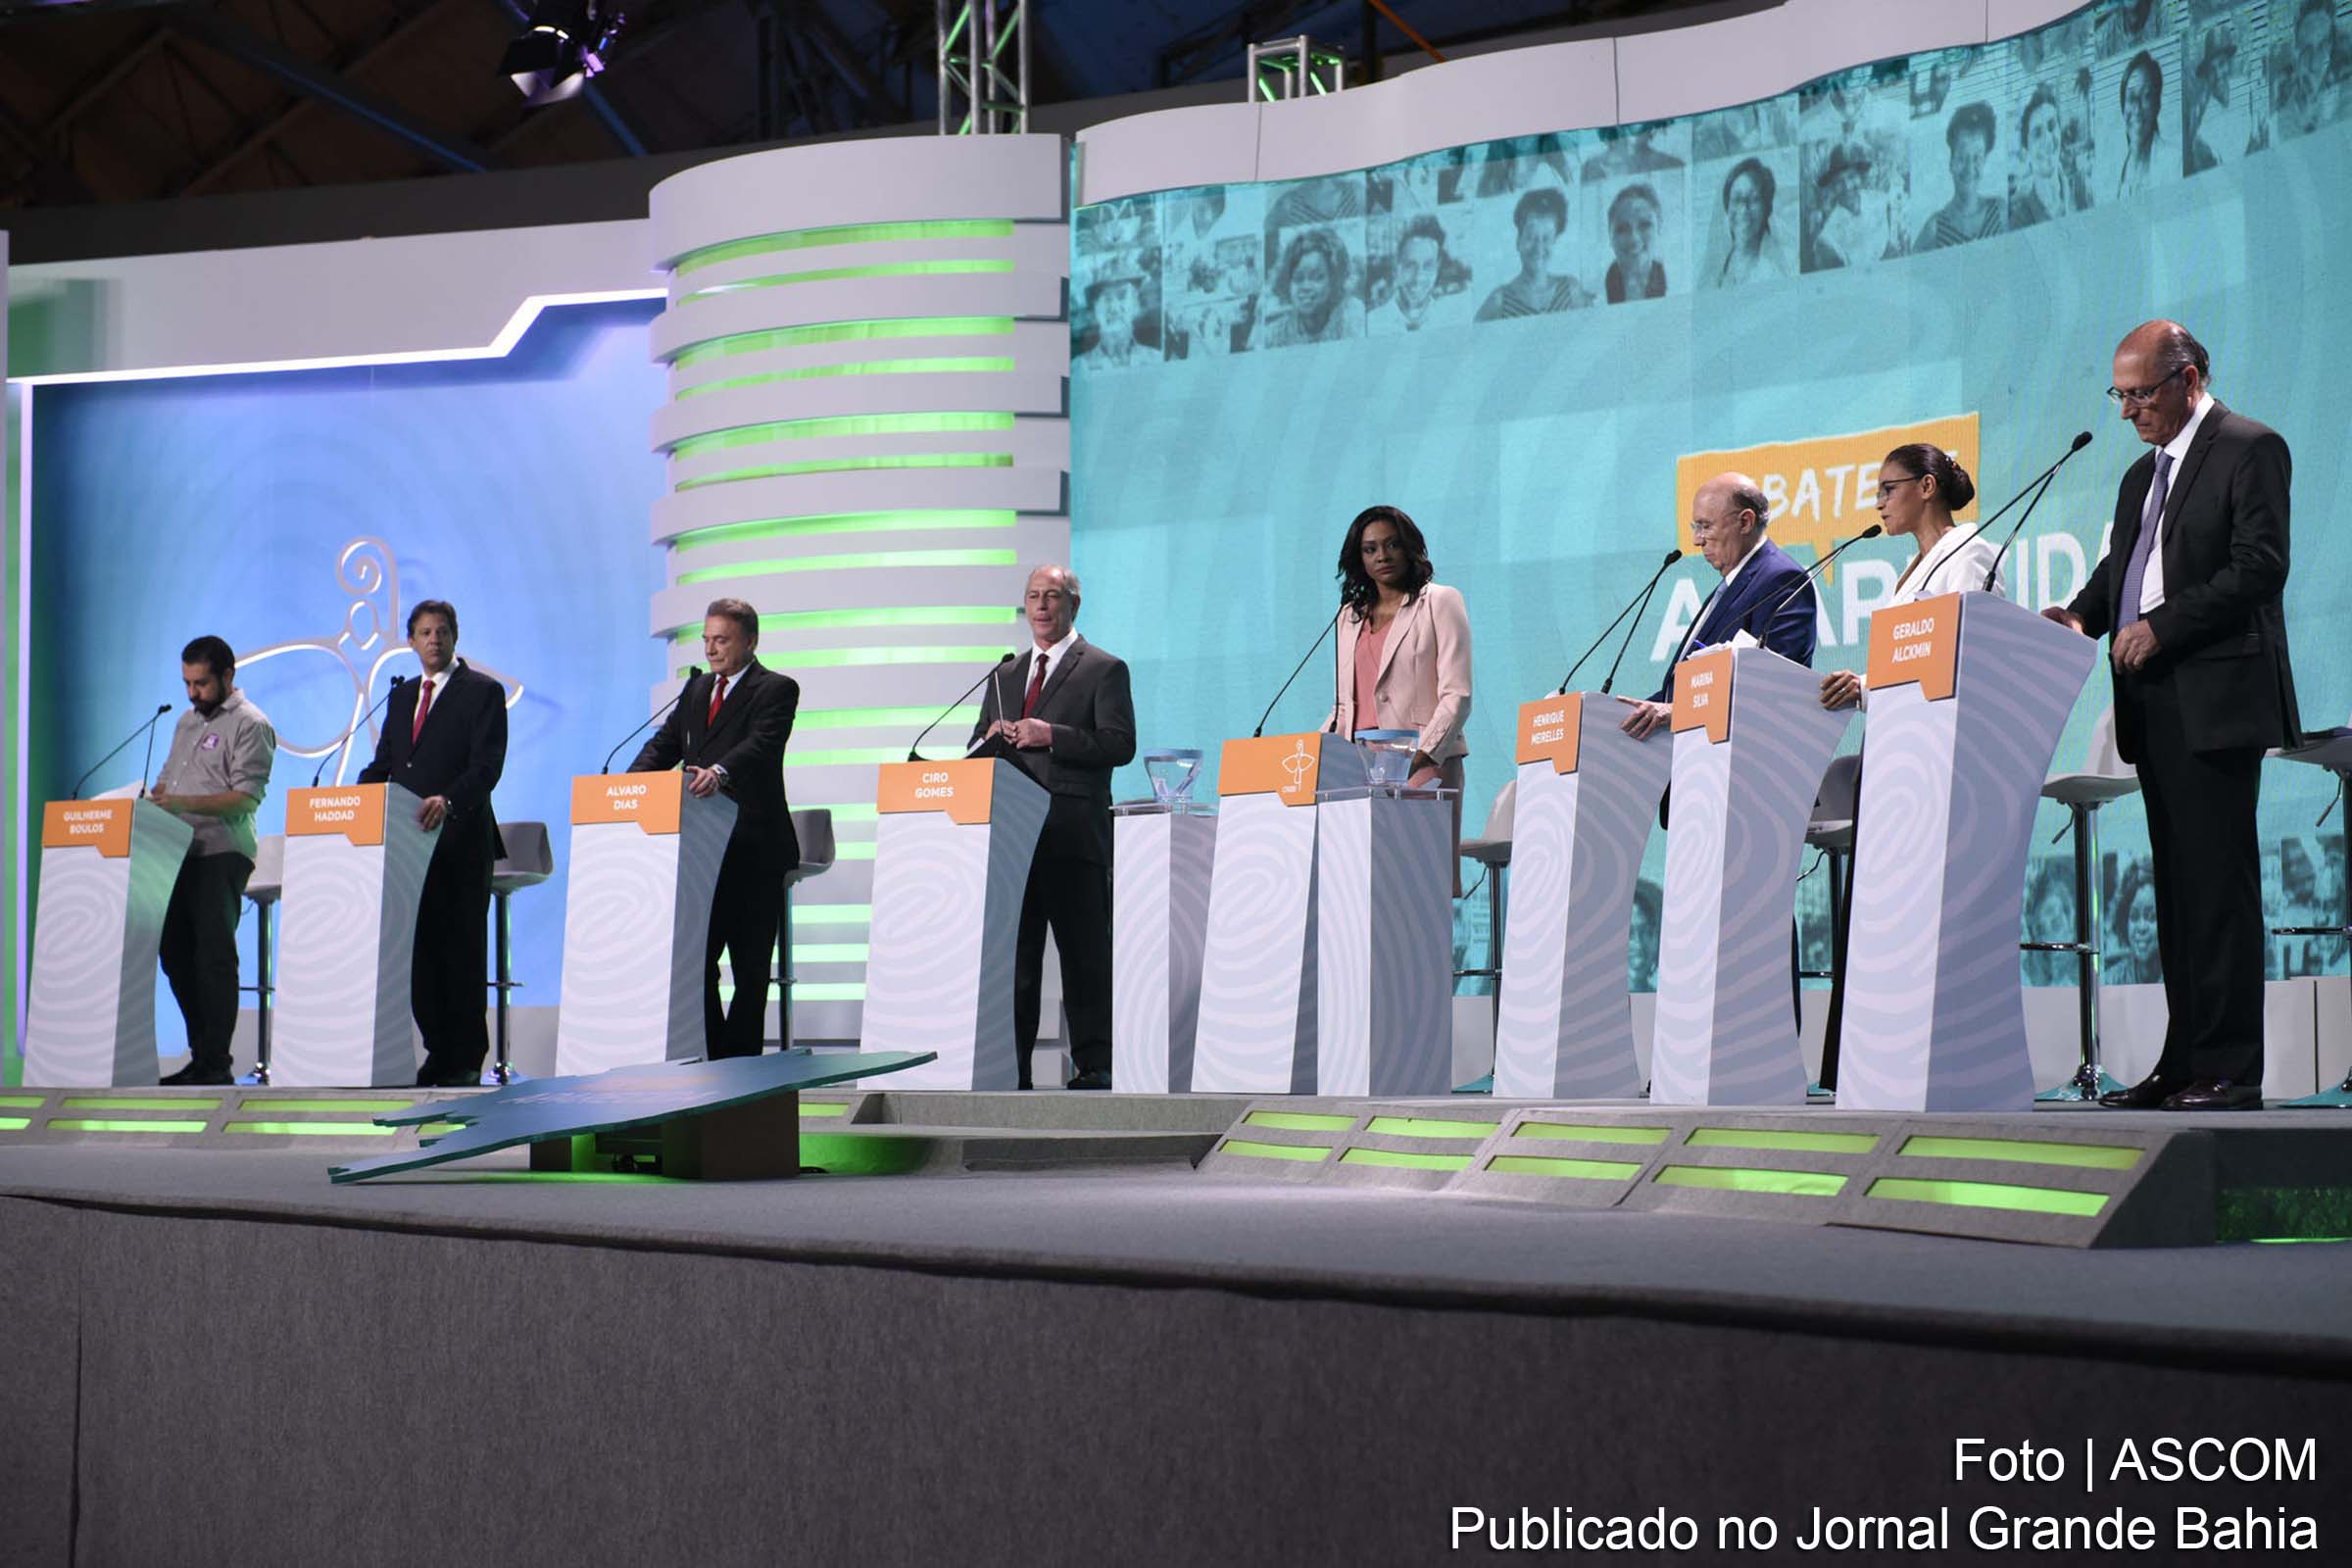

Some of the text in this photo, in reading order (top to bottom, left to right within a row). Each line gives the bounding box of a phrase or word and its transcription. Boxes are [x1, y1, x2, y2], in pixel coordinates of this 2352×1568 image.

[1762, 462, 1883, 523] BATE
[1892, 616, 1935, 640] GERALDO
[1891, 641, 1932, 663] ALCKMIN
[1692, 692, 1709, 710] SILVA
[1532, 710, 1565, 726] HENRIQUE
[1531, 728, 1564, 745] MEIRELLES
[921, 771, 950, 784] CIRO
[606, 784, 648, 797] ALVARO
[914, 785, 955, 800] GOMES
[309, 795, 362, 808] FERNANDO
[613, 799, 640, 810] DIAS
[63, 809, 113, 822] GUILHERME
[314, 809, 356, 822] HADDAD
[70, 823, 105, 834] BOULOS
